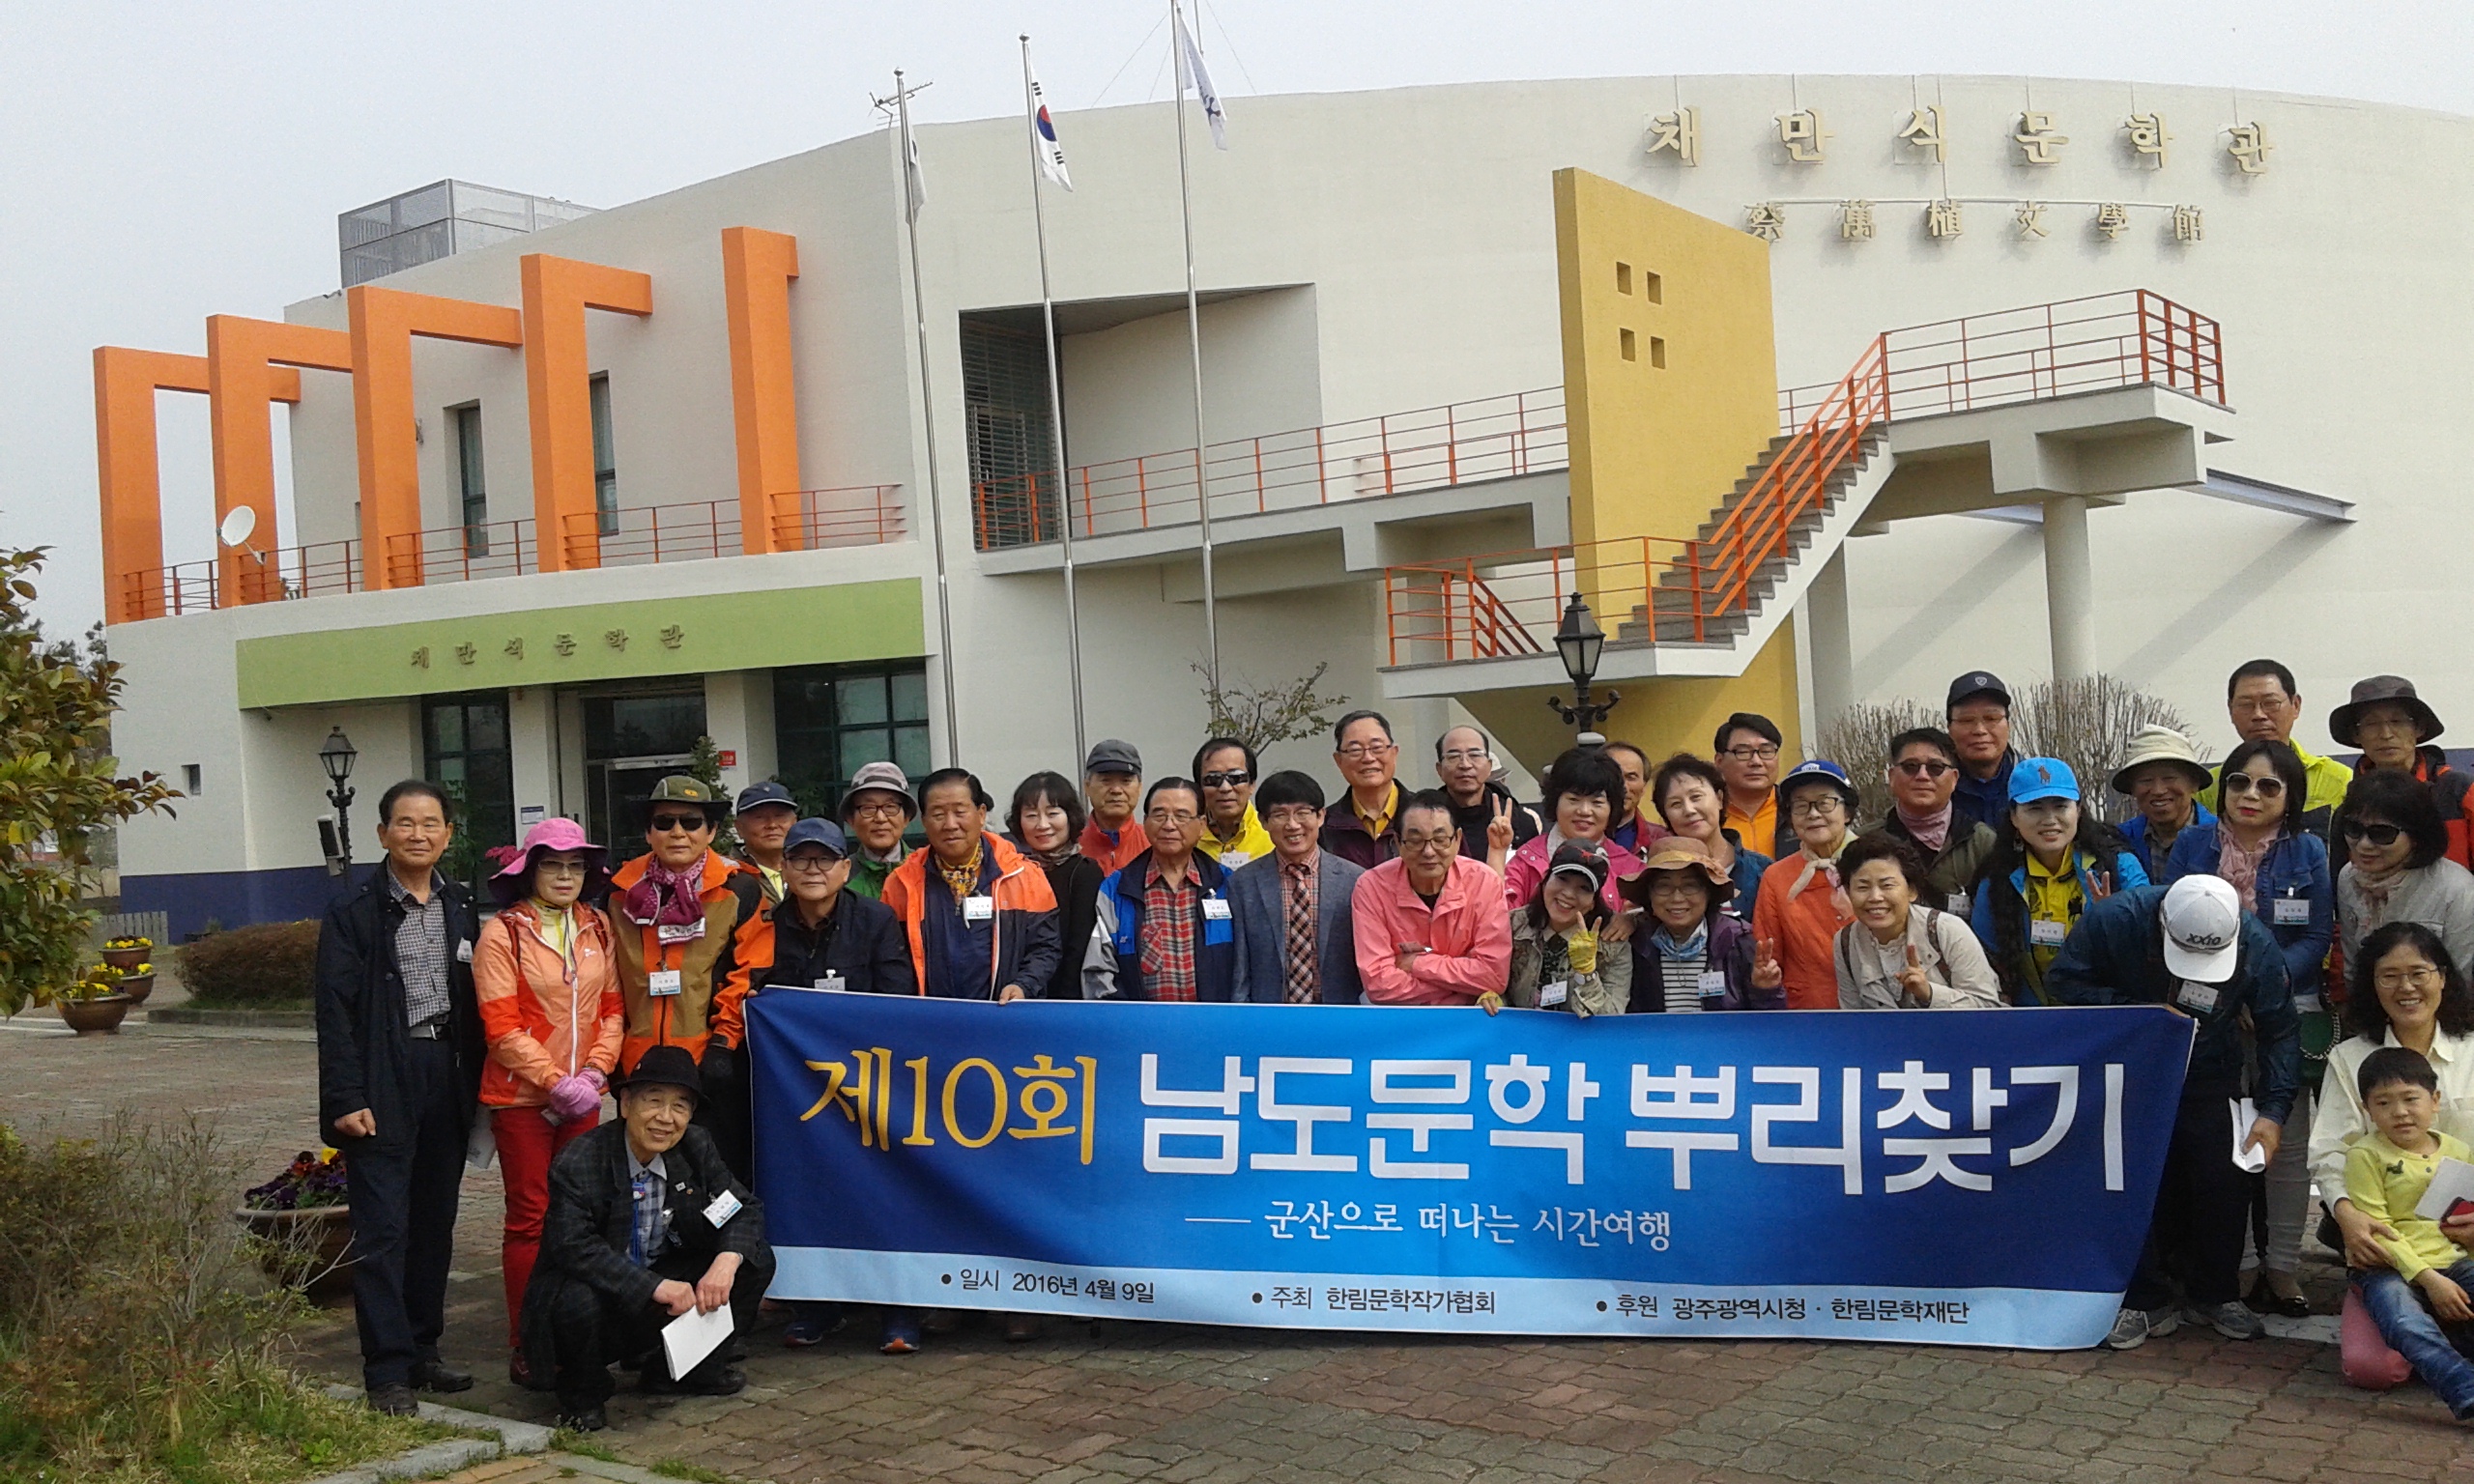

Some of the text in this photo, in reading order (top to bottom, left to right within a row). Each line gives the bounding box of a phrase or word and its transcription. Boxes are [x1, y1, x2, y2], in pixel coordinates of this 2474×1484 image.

[1646, 104, 2270, 176] 채만식문학관
[799, 1046, 2125, 1195] 제10회 남도문학 뿌리찾기
[1264, 1201, 1672, 1252] 군산으로 떠나는 시간여행
[960, 1269, 1155, 1304] 일시 2016년 4월 9일
[1270, 1286, 1496, 1314] 주최 한림문학작가협회
[1615, 1294, 1971, 1325] 후원 광주광역시청 한림문학재단
